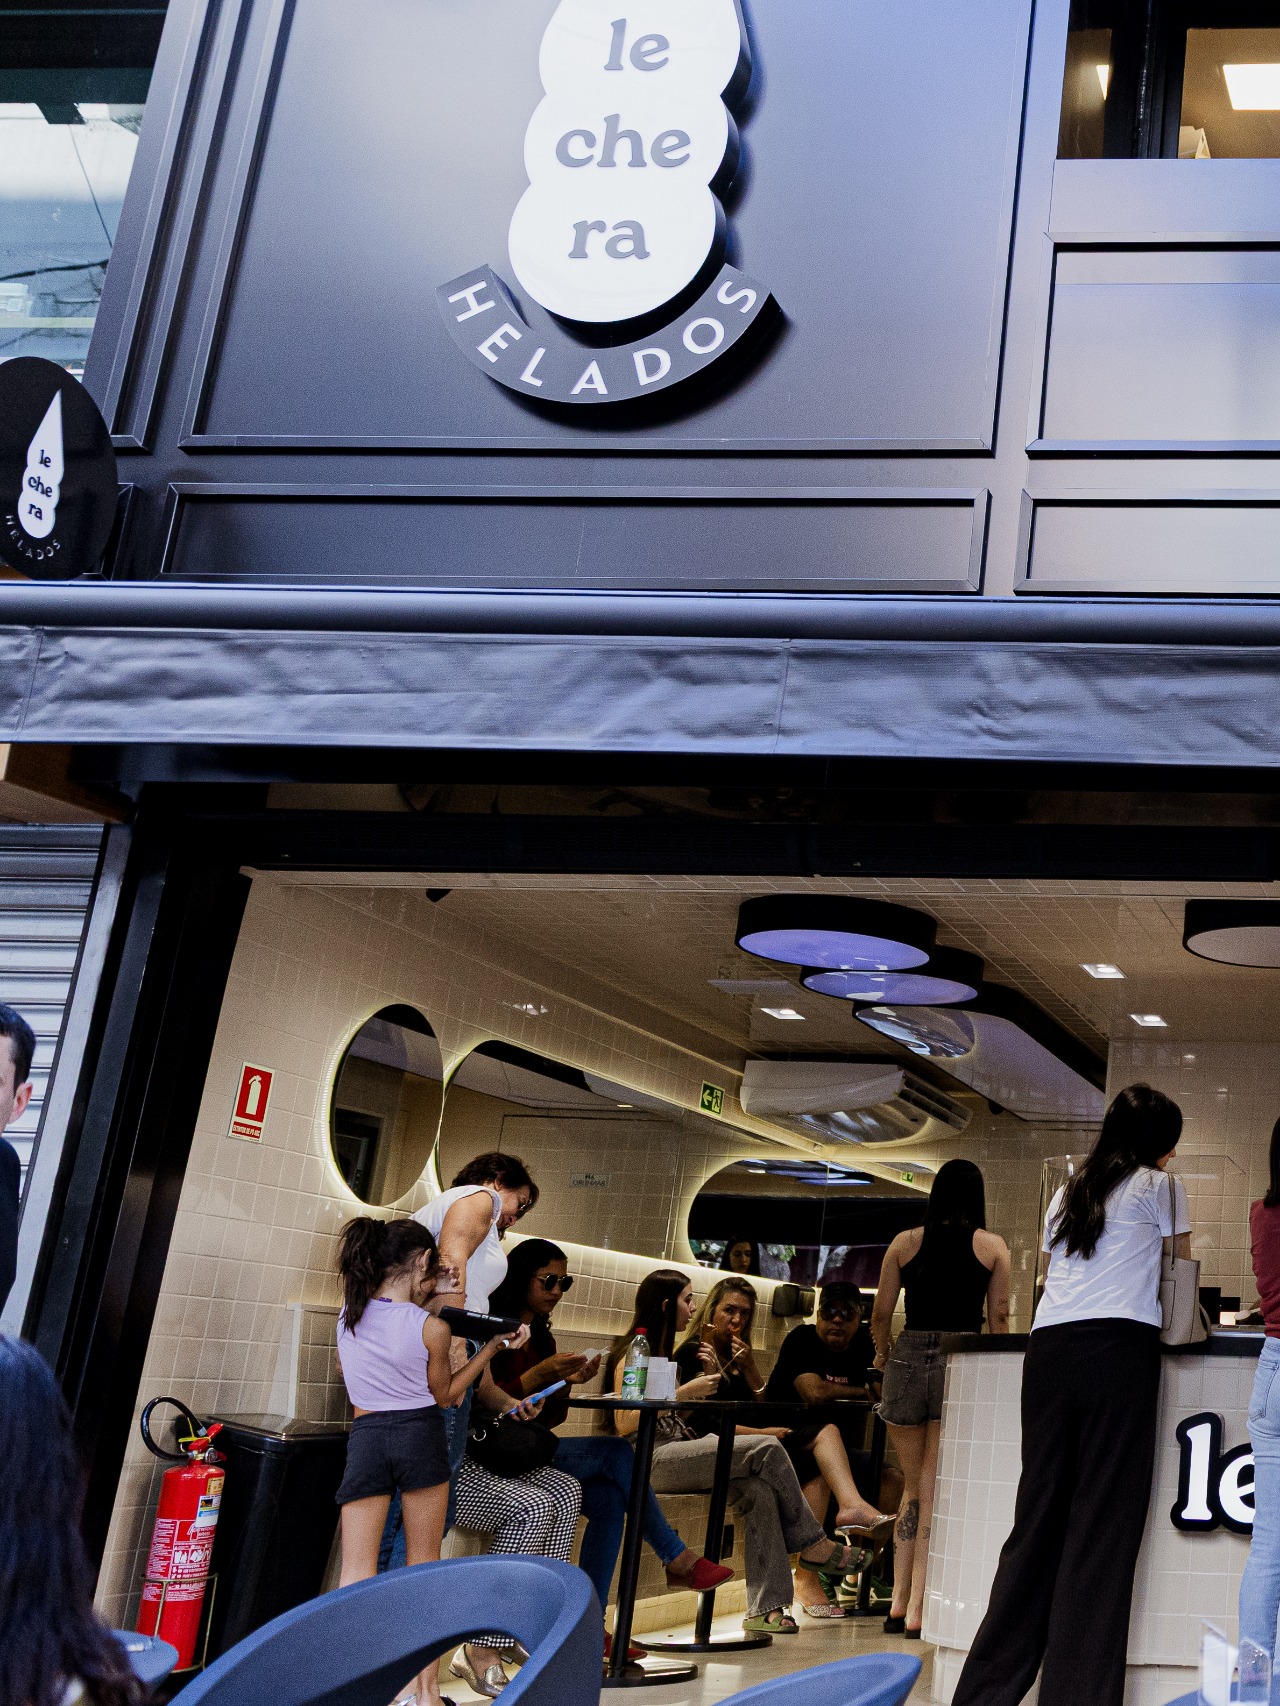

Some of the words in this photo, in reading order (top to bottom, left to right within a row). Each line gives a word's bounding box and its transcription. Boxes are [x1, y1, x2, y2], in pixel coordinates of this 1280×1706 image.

[604, 18, 670, 71] le
[555, 113, 691, 168] che
[568, 220, 650, 260] ra
[448, 280, 757, 395] HELADOS
[39, 449, 51, 468] le
[28, 476, 53, 498] che
[28, 503, 43, 520] ra
[5, 515, 60, 560] HELADOS
